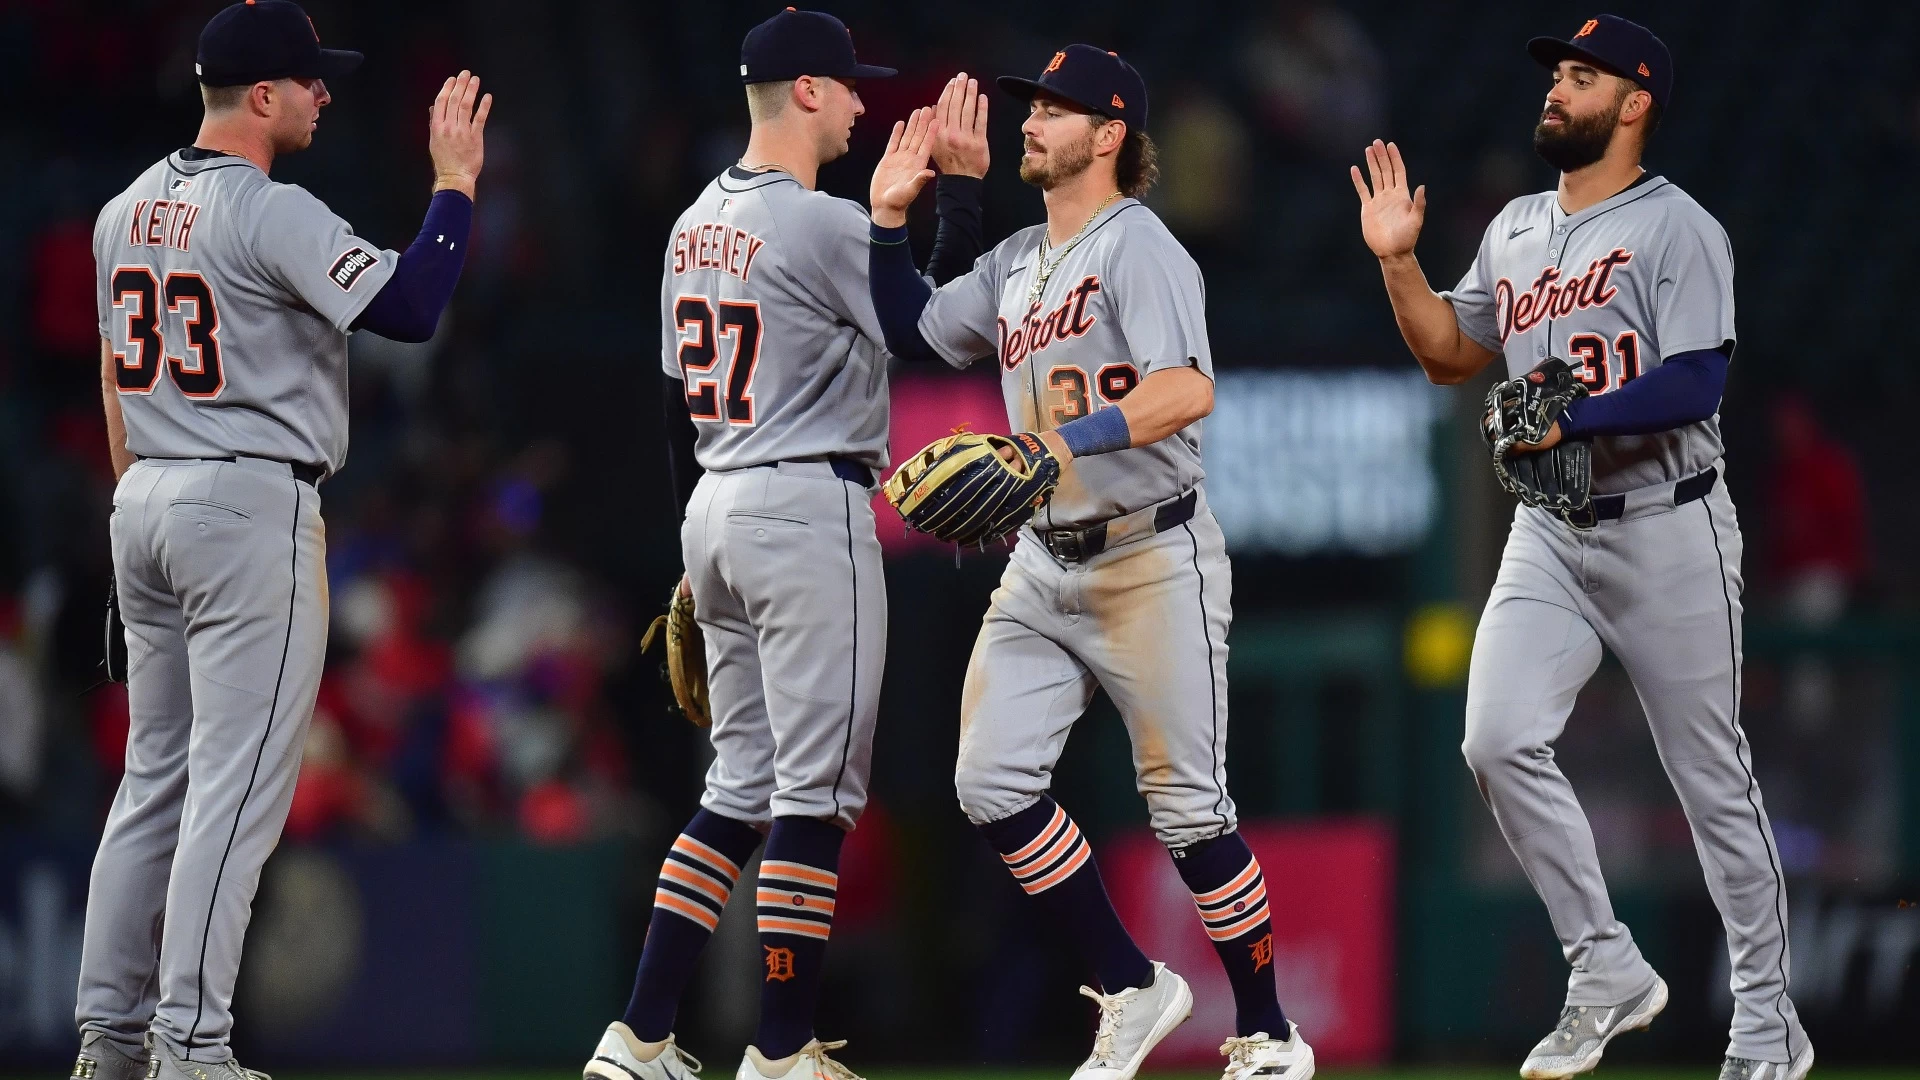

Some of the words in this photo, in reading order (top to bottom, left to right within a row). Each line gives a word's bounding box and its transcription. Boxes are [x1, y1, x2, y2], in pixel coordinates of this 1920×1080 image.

[129, 199, 201, 252] KEITH
[673, 222, 766, 284] SWEENEY
[335, 251, 370, 284] meijer
[1496, 247, 1634, 349] Detroit
[111, 264, 226, 400] 33
[998, 275, 1100, 373] Detroit
[673, 293, 764, 427] 27
[1568, 330, 1642, 397] 31
[764, 944, 796, 982] D
